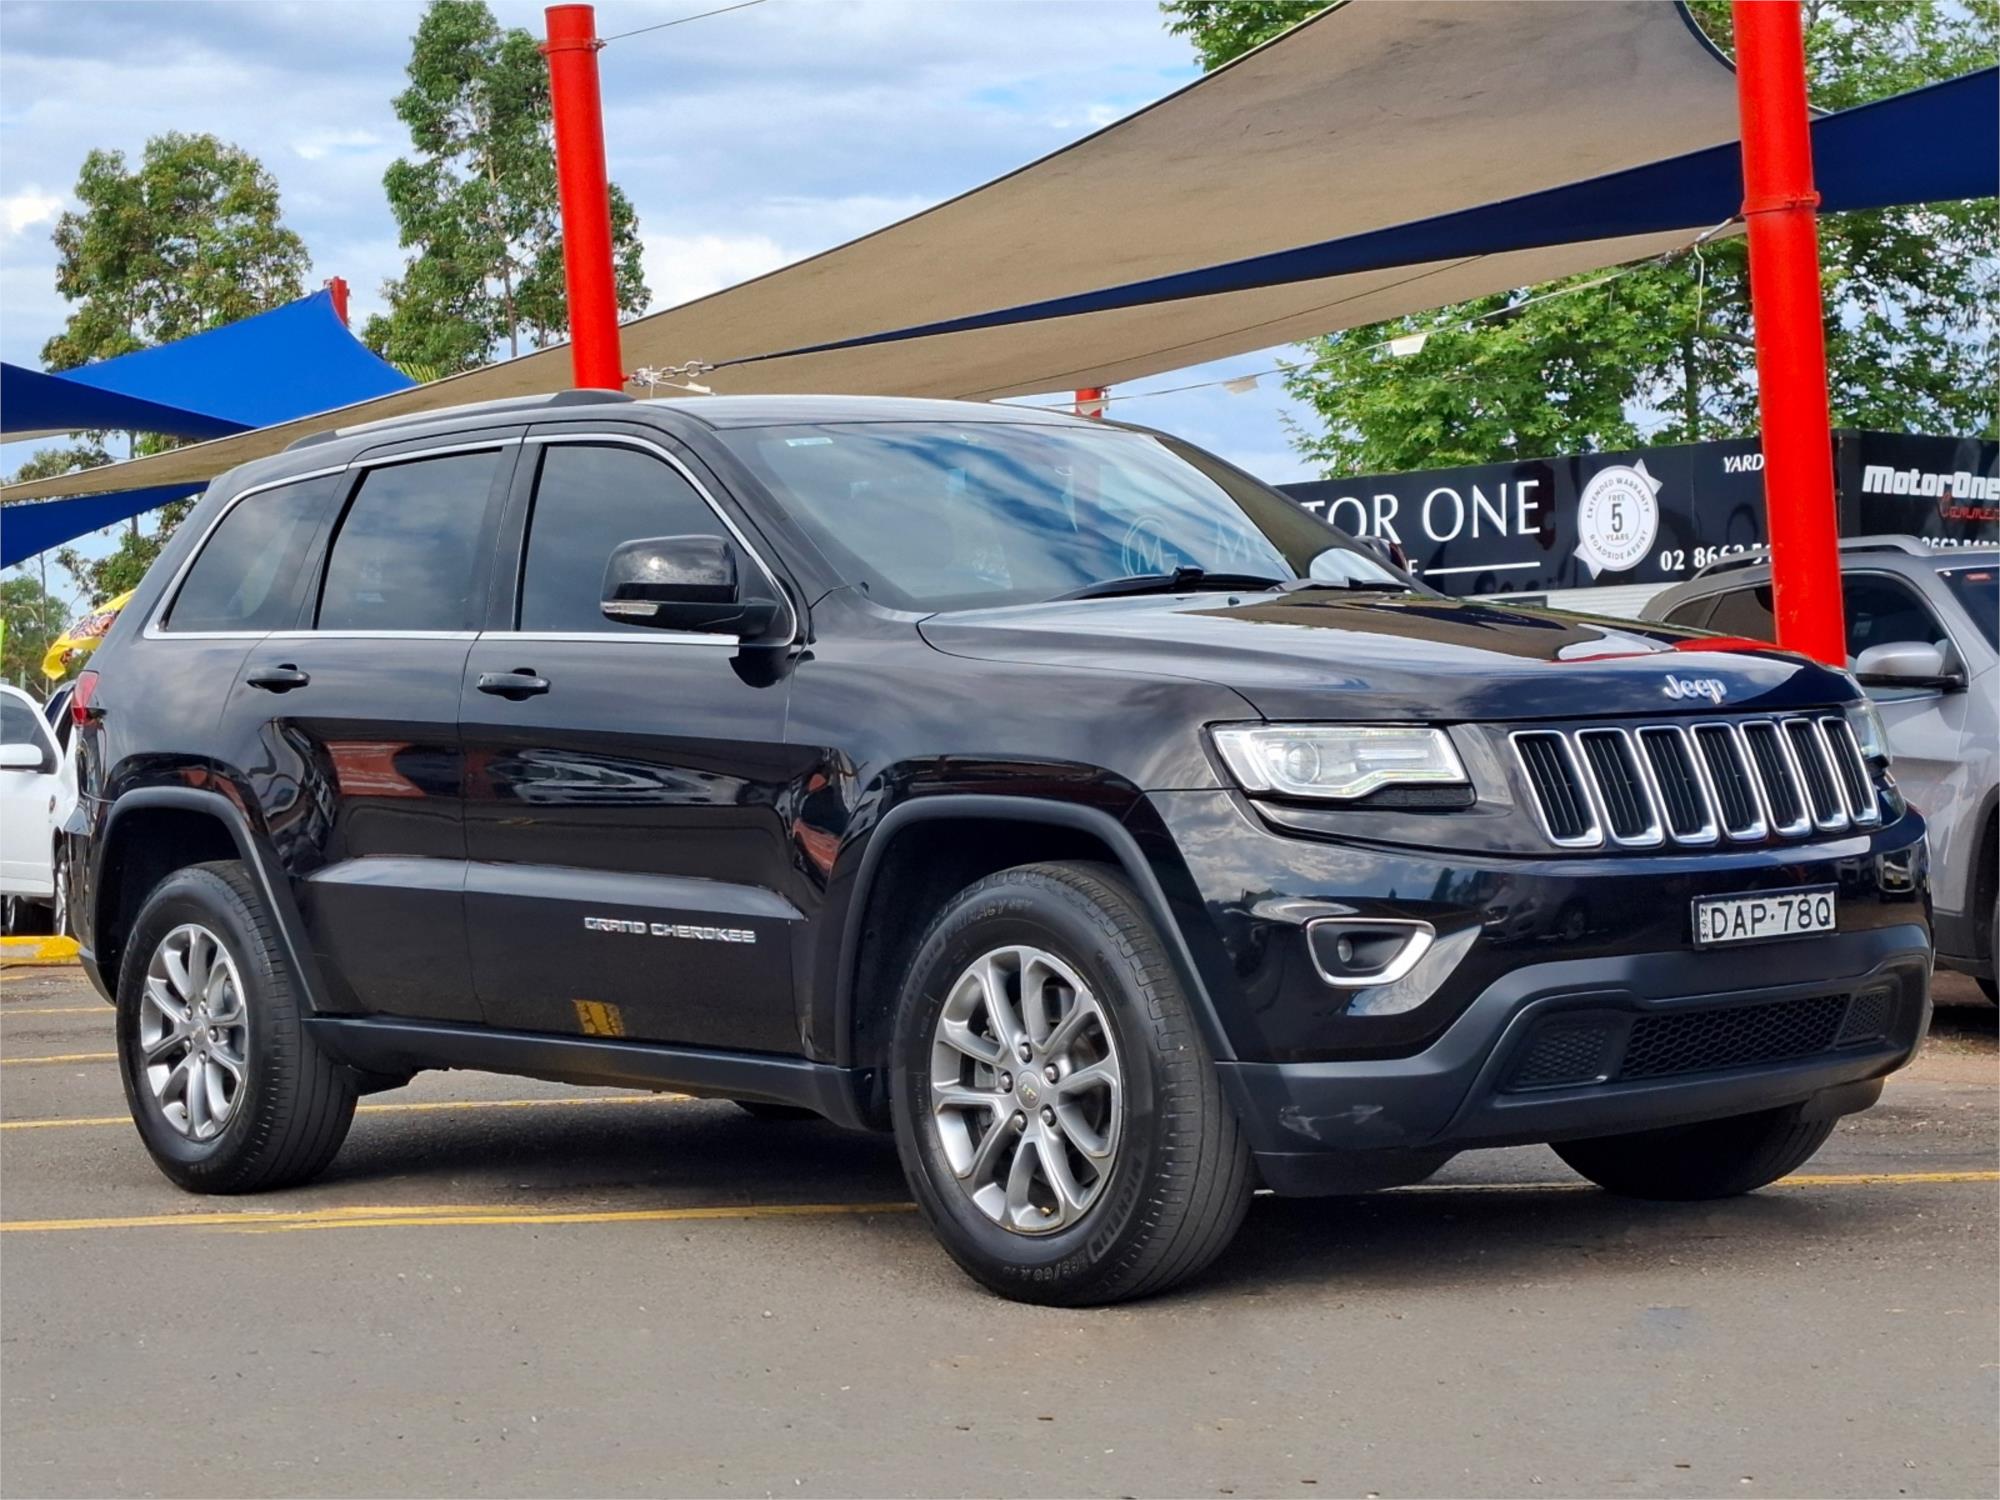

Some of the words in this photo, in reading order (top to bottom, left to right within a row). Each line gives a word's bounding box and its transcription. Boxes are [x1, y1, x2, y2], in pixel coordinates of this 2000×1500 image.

[1723, 453, 1765, 473] YARD
[1422, 479, 1541, 542] ONE
[1611, 502, 1624, 533] 5
[1605, 533, 1630, 541] YEARS
[1660, 549, 1685, 571] 02
[1662, 674, 1727, 704] Jeep
[584, 916, 647, 934] GRAND
[650, 922, 757, 943] CHEROKEE
